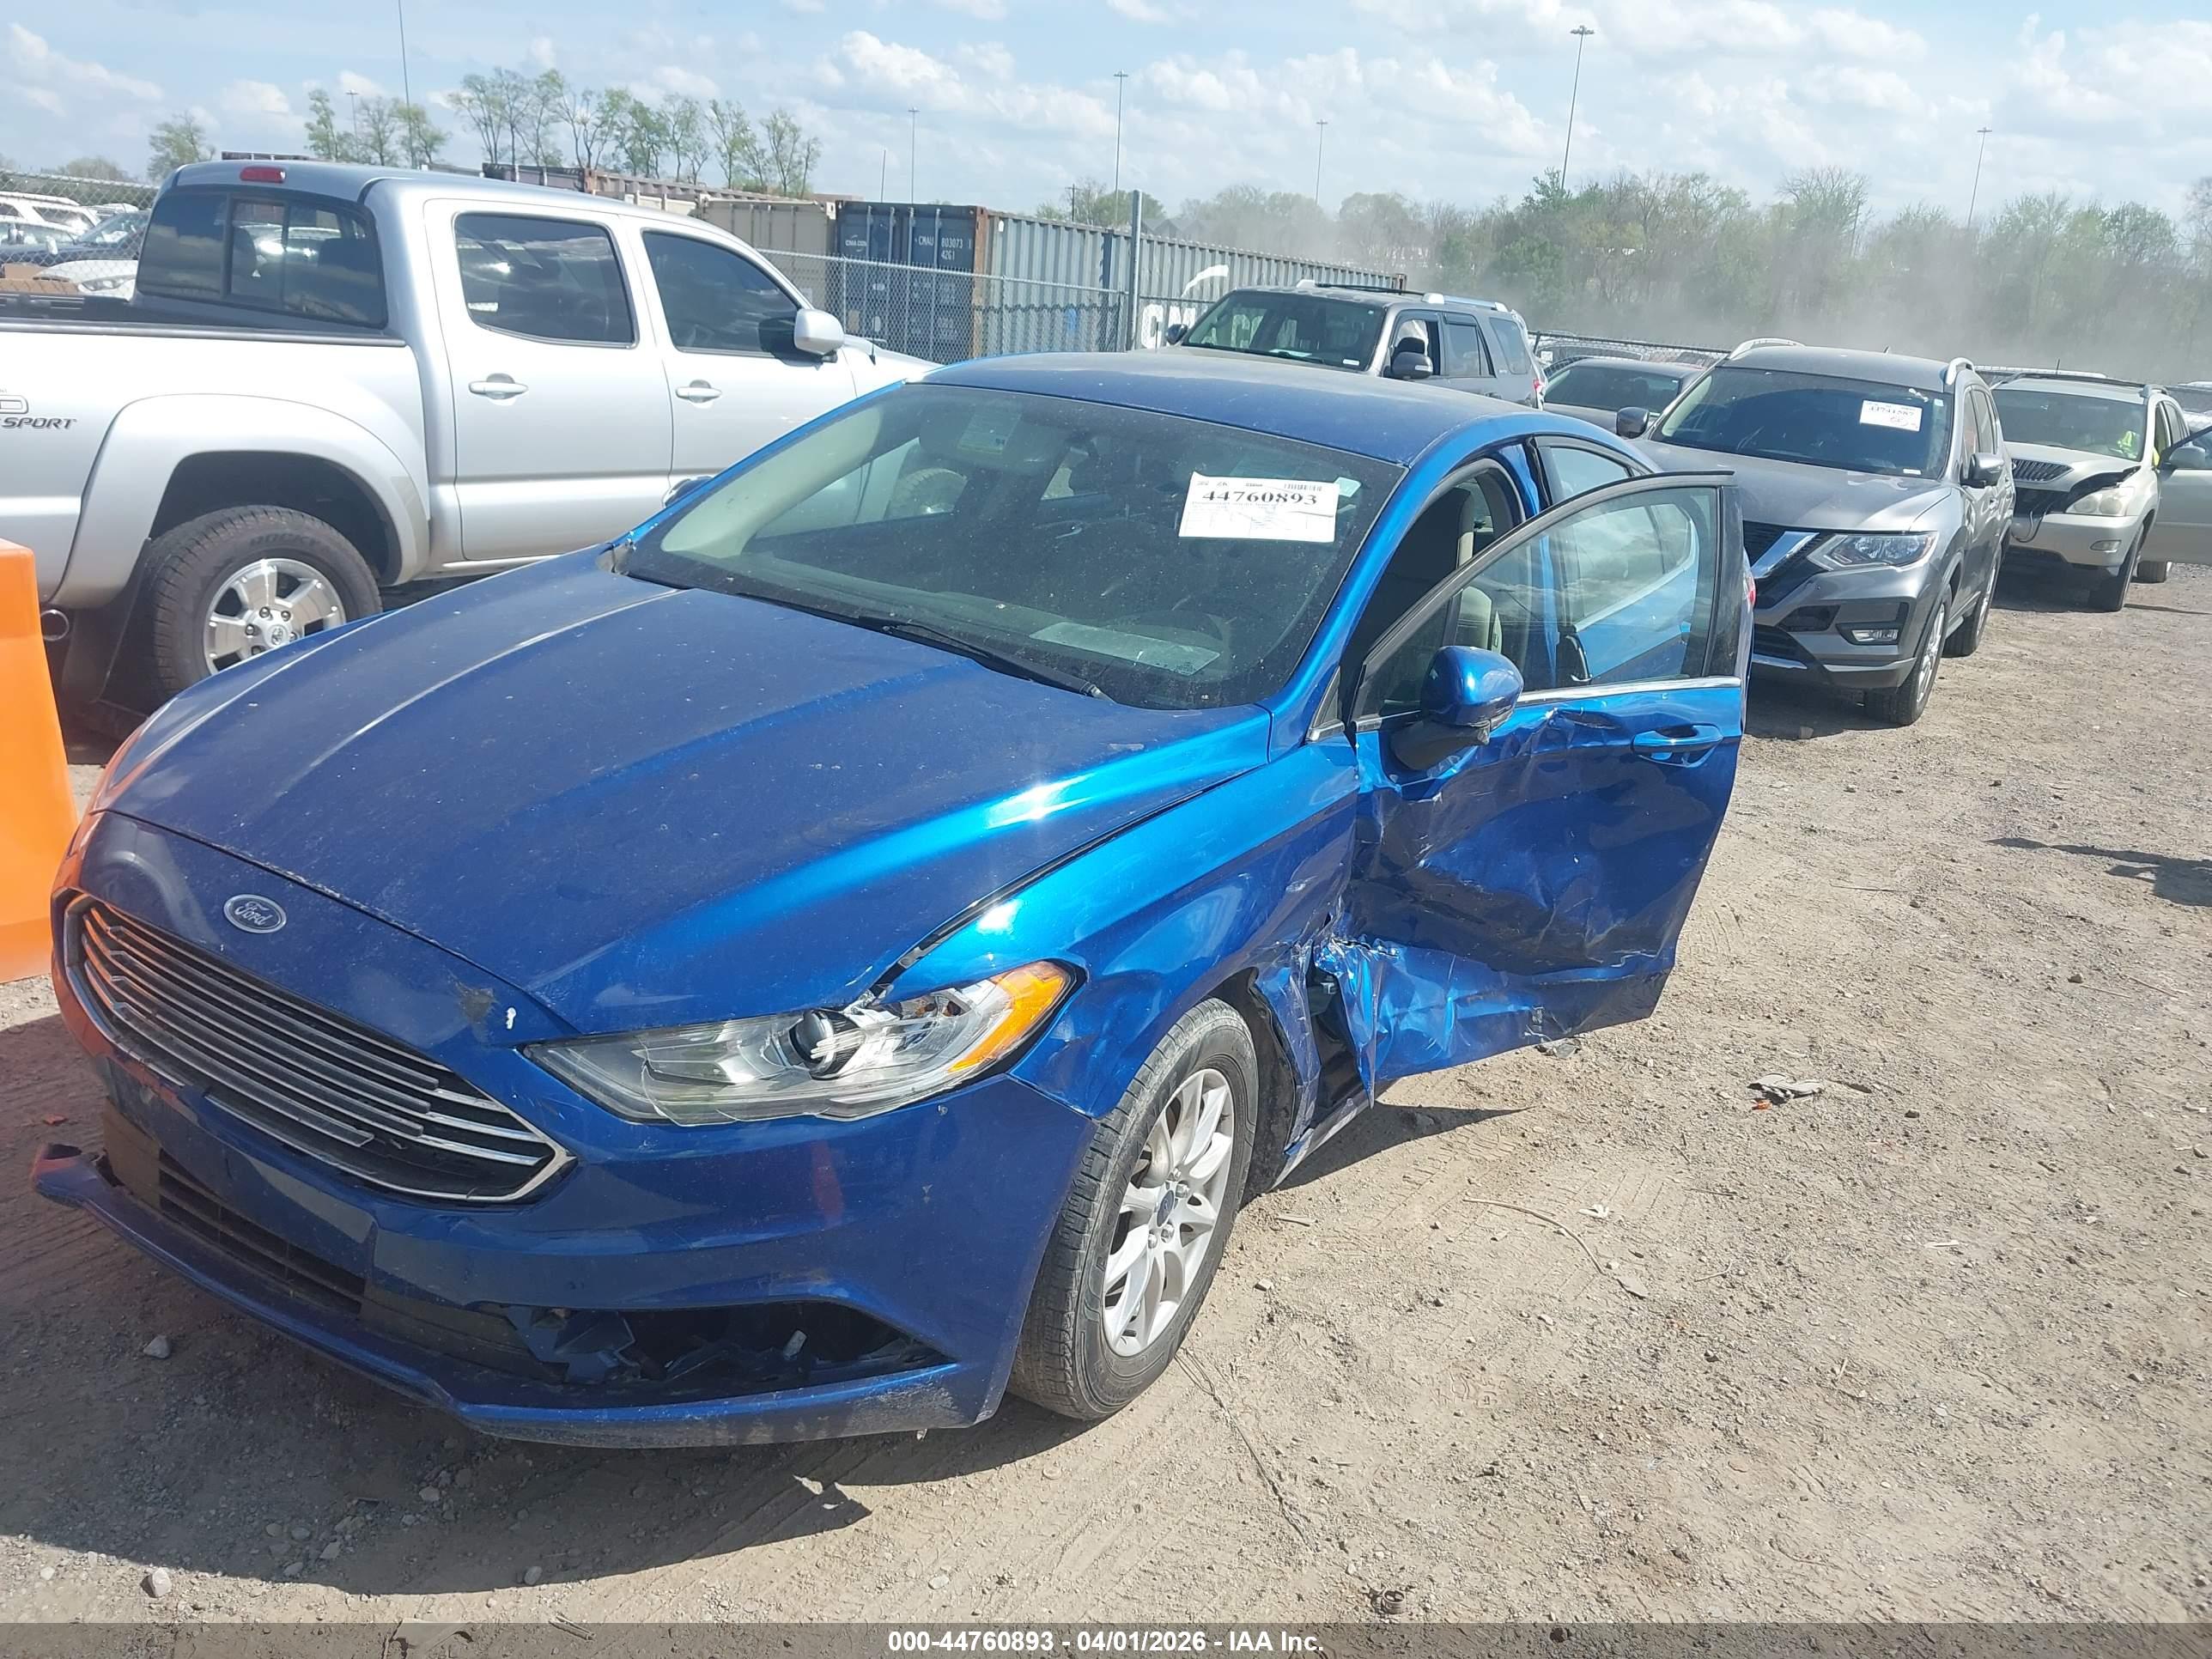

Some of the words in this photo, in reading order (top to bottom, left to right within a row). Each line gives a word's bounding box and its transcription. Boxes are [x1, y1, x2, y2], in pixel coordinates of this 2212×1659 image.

[919, 235, 934, 246] CMAU
[941, 238, 963, 249] 803073
[2, 417, 72, 429] SPORT
[1202, 490, 1317, 506] 44760893
[234, 902, 273, 925] Ford
